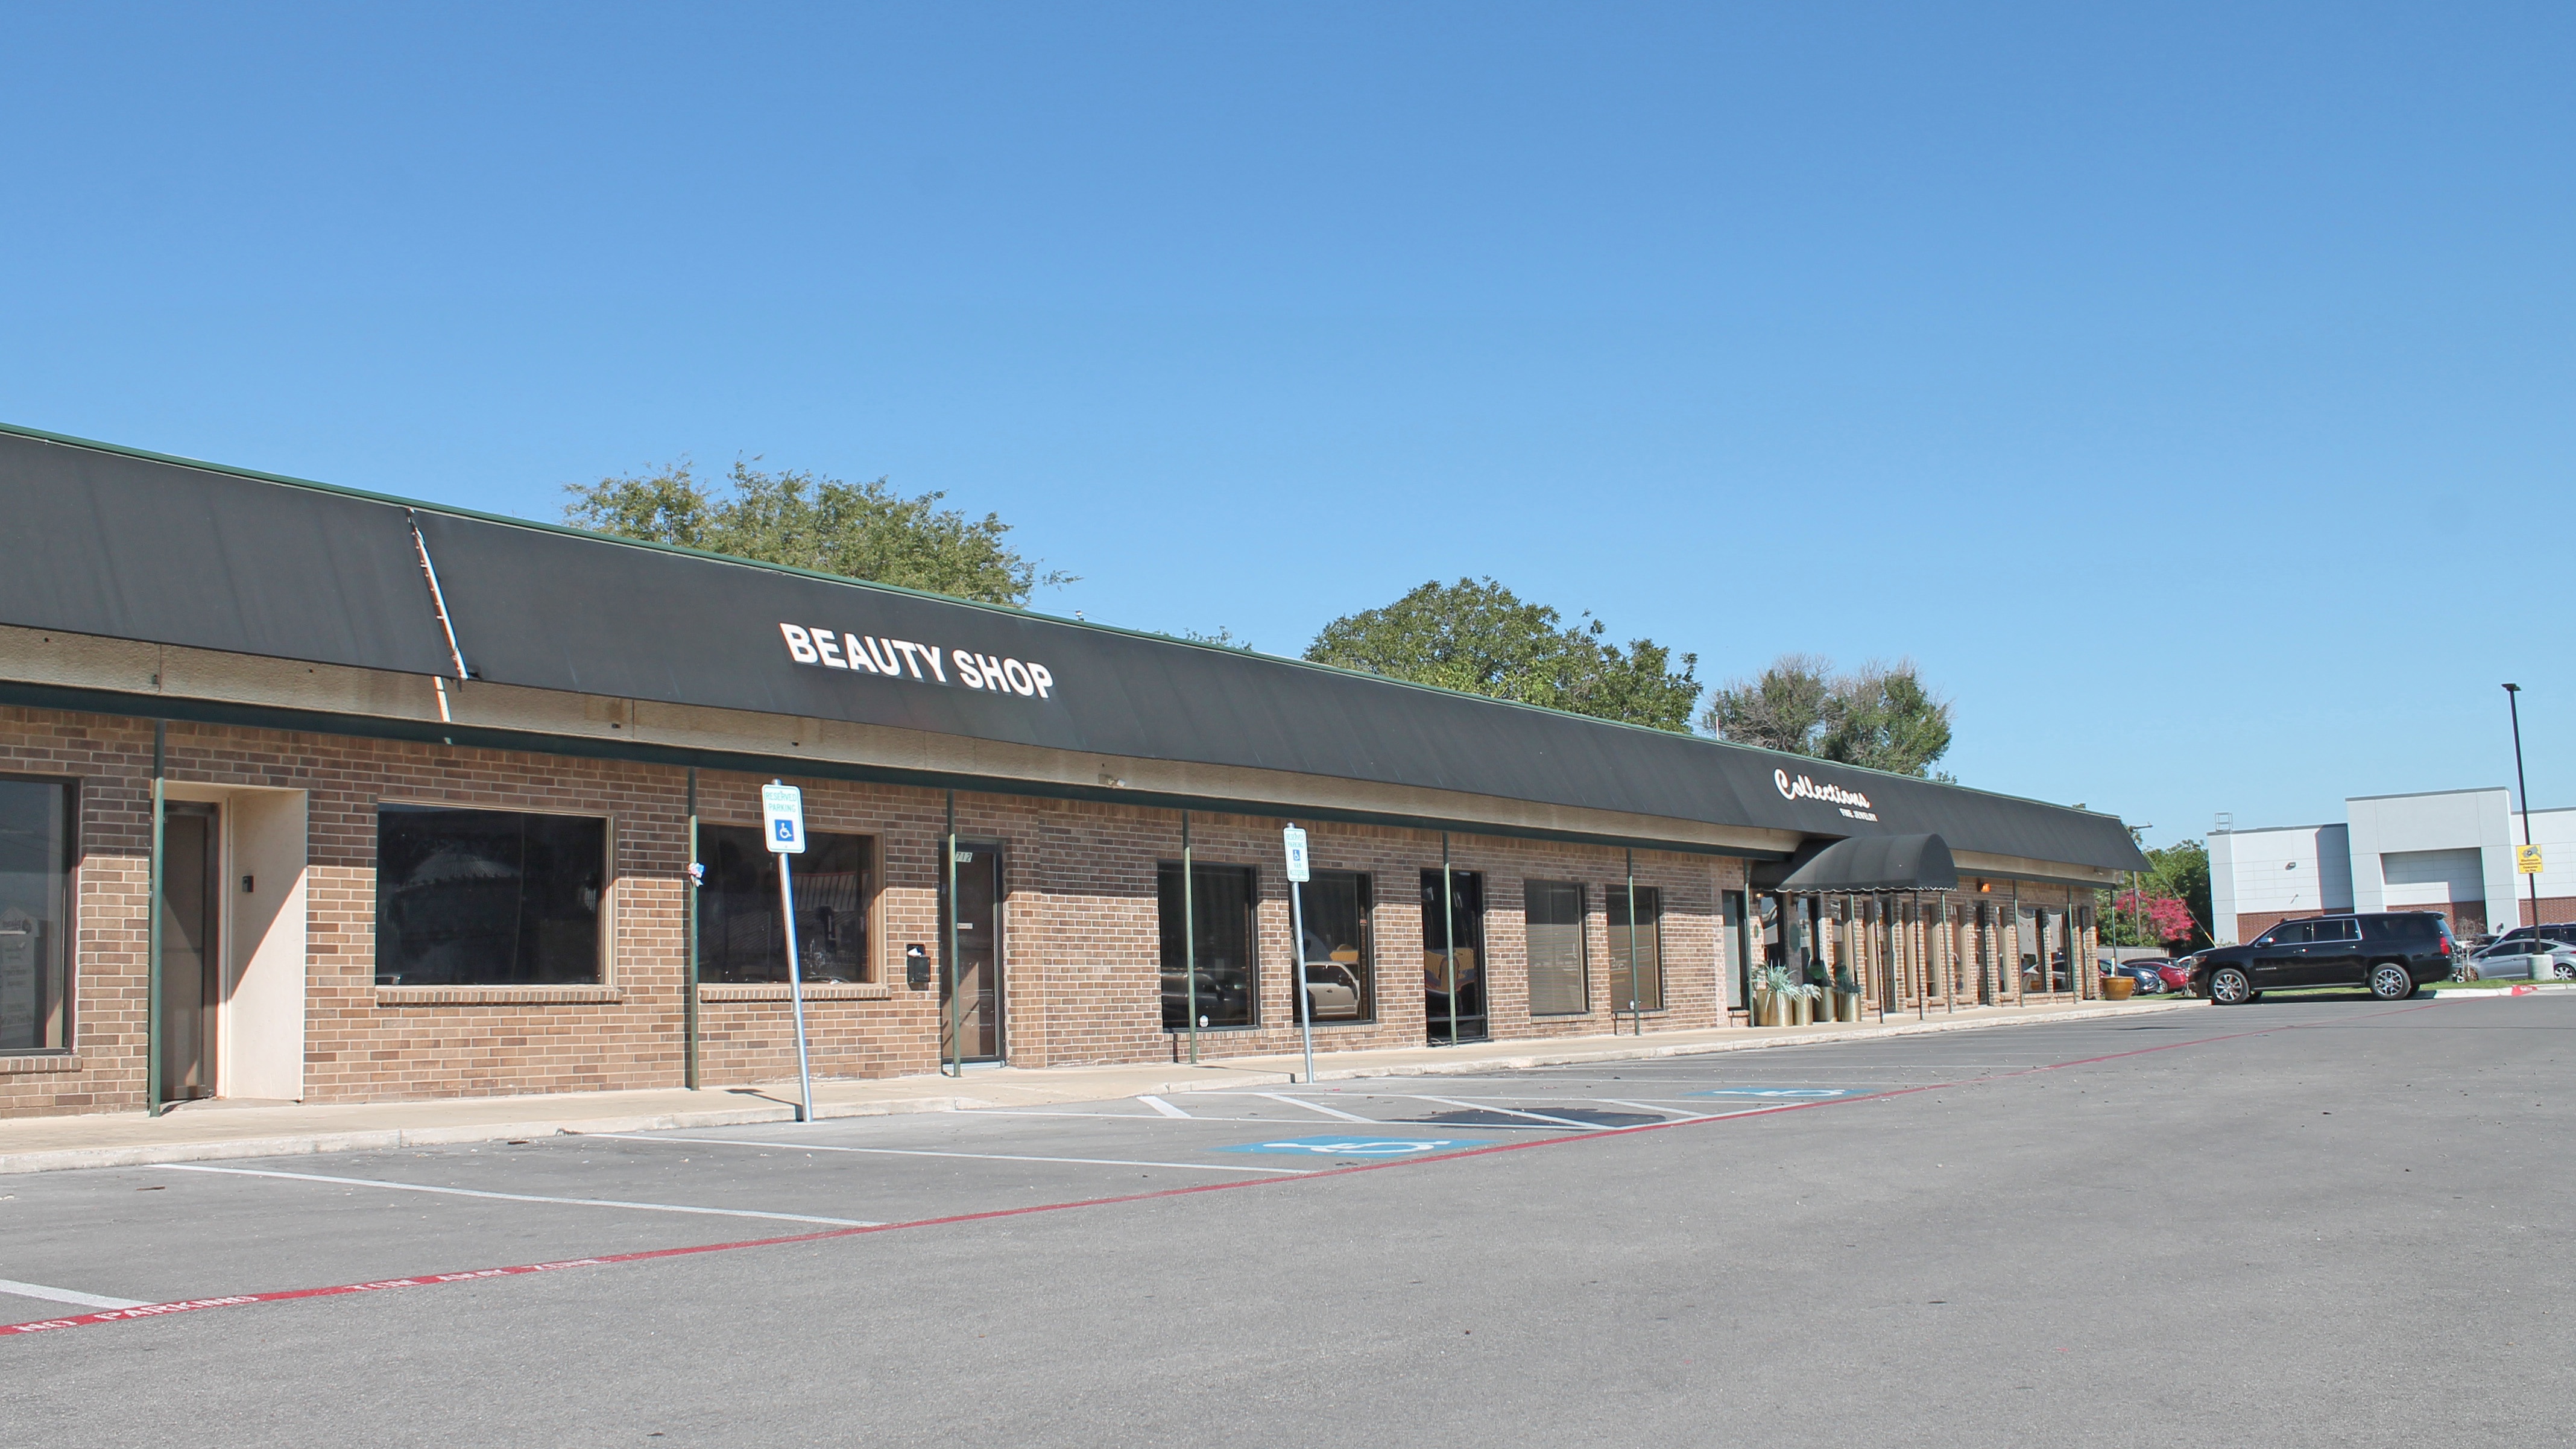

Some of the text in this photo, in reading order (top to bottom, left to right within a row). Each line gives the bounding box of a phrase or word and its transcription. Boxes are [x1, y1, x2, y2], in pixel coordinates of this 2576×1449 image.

[778, 622, 1054, 698] BEAUTY SHOP
[765, 792, 797, 801] RESERVED
[1773, 768, 1871, 809] Collections
[768, 803, 797, 812] PARKING
[12, 1320, 77, 1332] NO
[93, 1295, 259, 1321] PARKING
